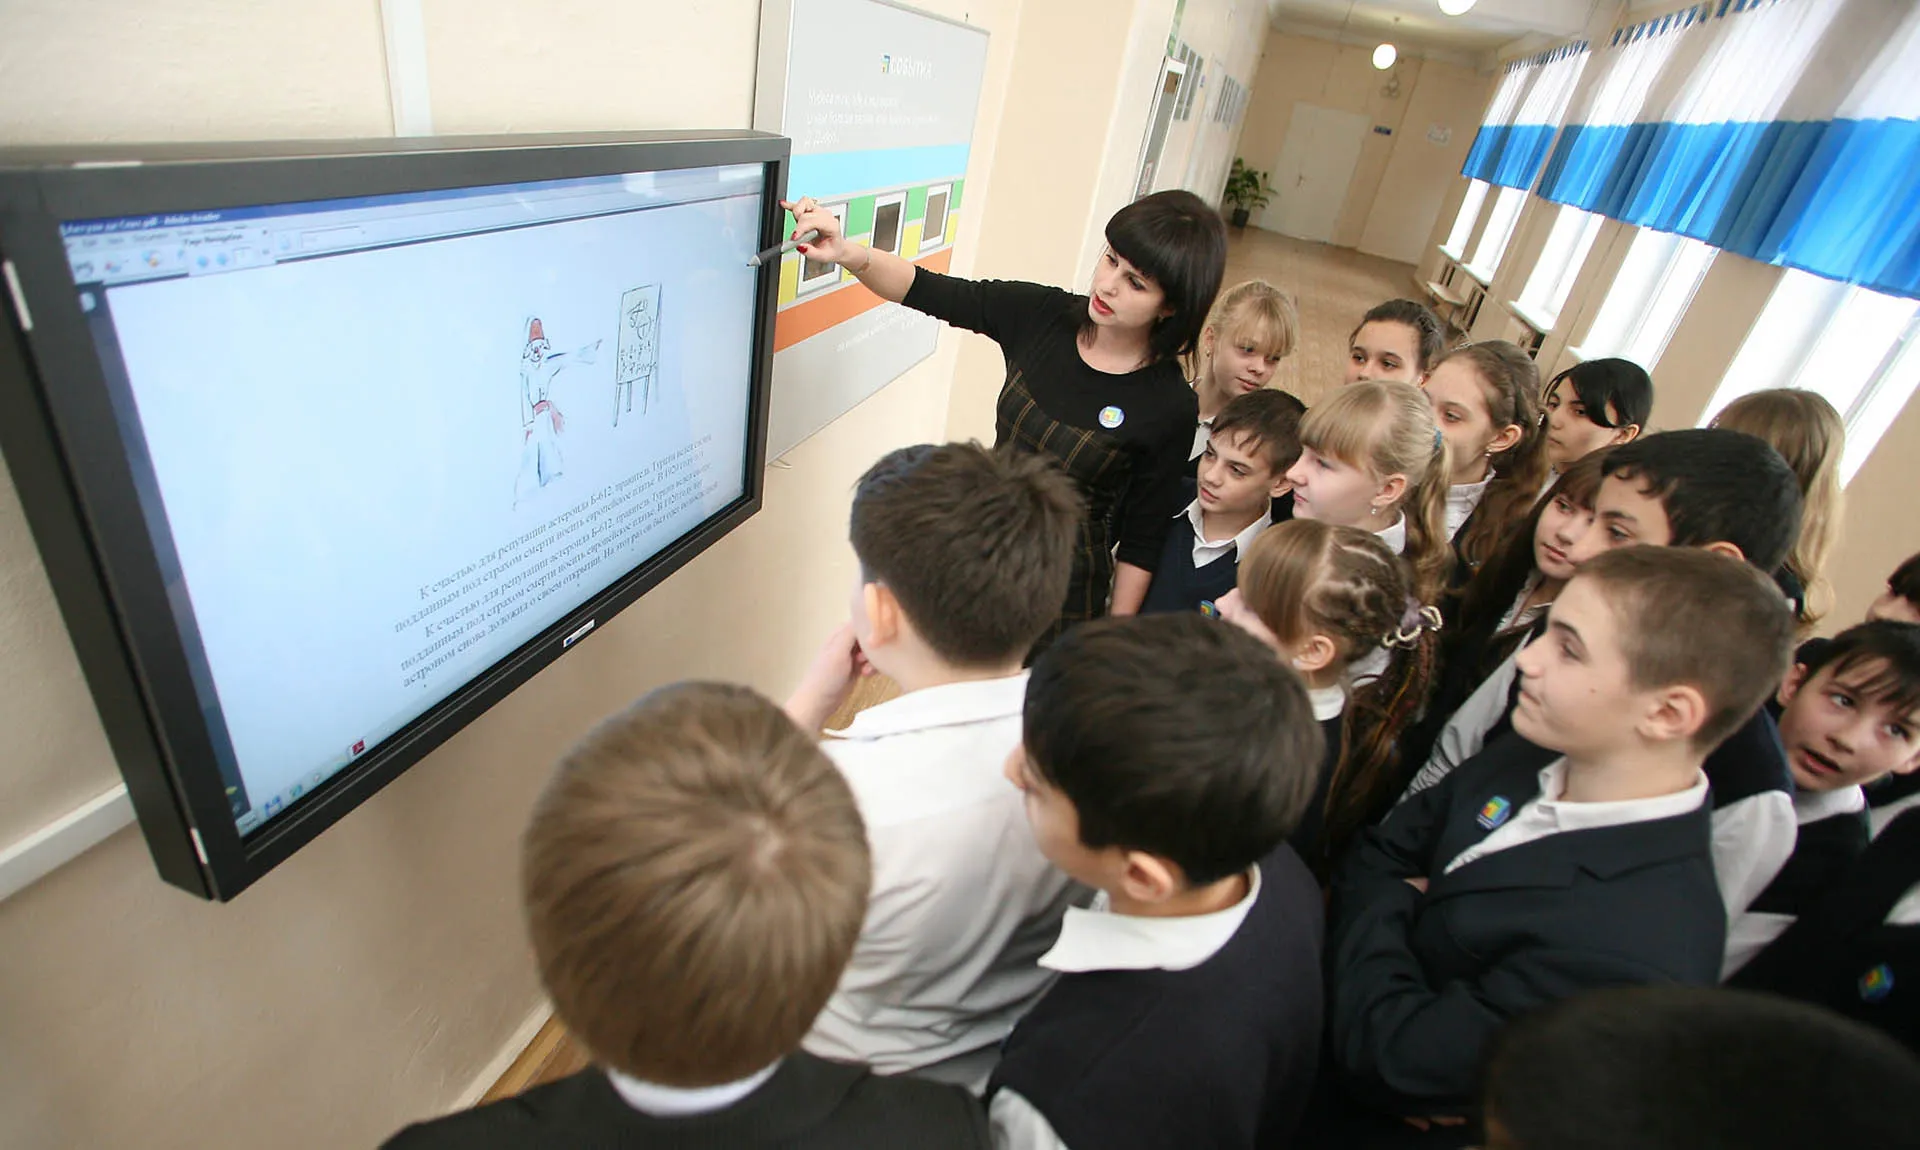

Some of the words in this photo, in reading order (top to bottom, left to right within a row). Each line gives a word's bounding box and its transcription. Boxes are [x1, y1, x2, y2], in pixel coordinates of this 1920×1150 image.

[394, 590, 460, 632] подданным
[462, 577, 482, 596] под
[483, 554, 522, 581] страхом
[523, 535, 555, 558] смерти
[418, 584, 430, 600] К
[431, 563, 476, 592] счастью
[400, 626, 464, 672] подданным
[465, 612, 486, 631] под
[487, 588, 525, 616] страхом
[526, 568, 556, 594] смерти
[424, 622, 435, 639] К
[436, 599, 480, 630] счастью
[403, 648, 455, 688] астроном
